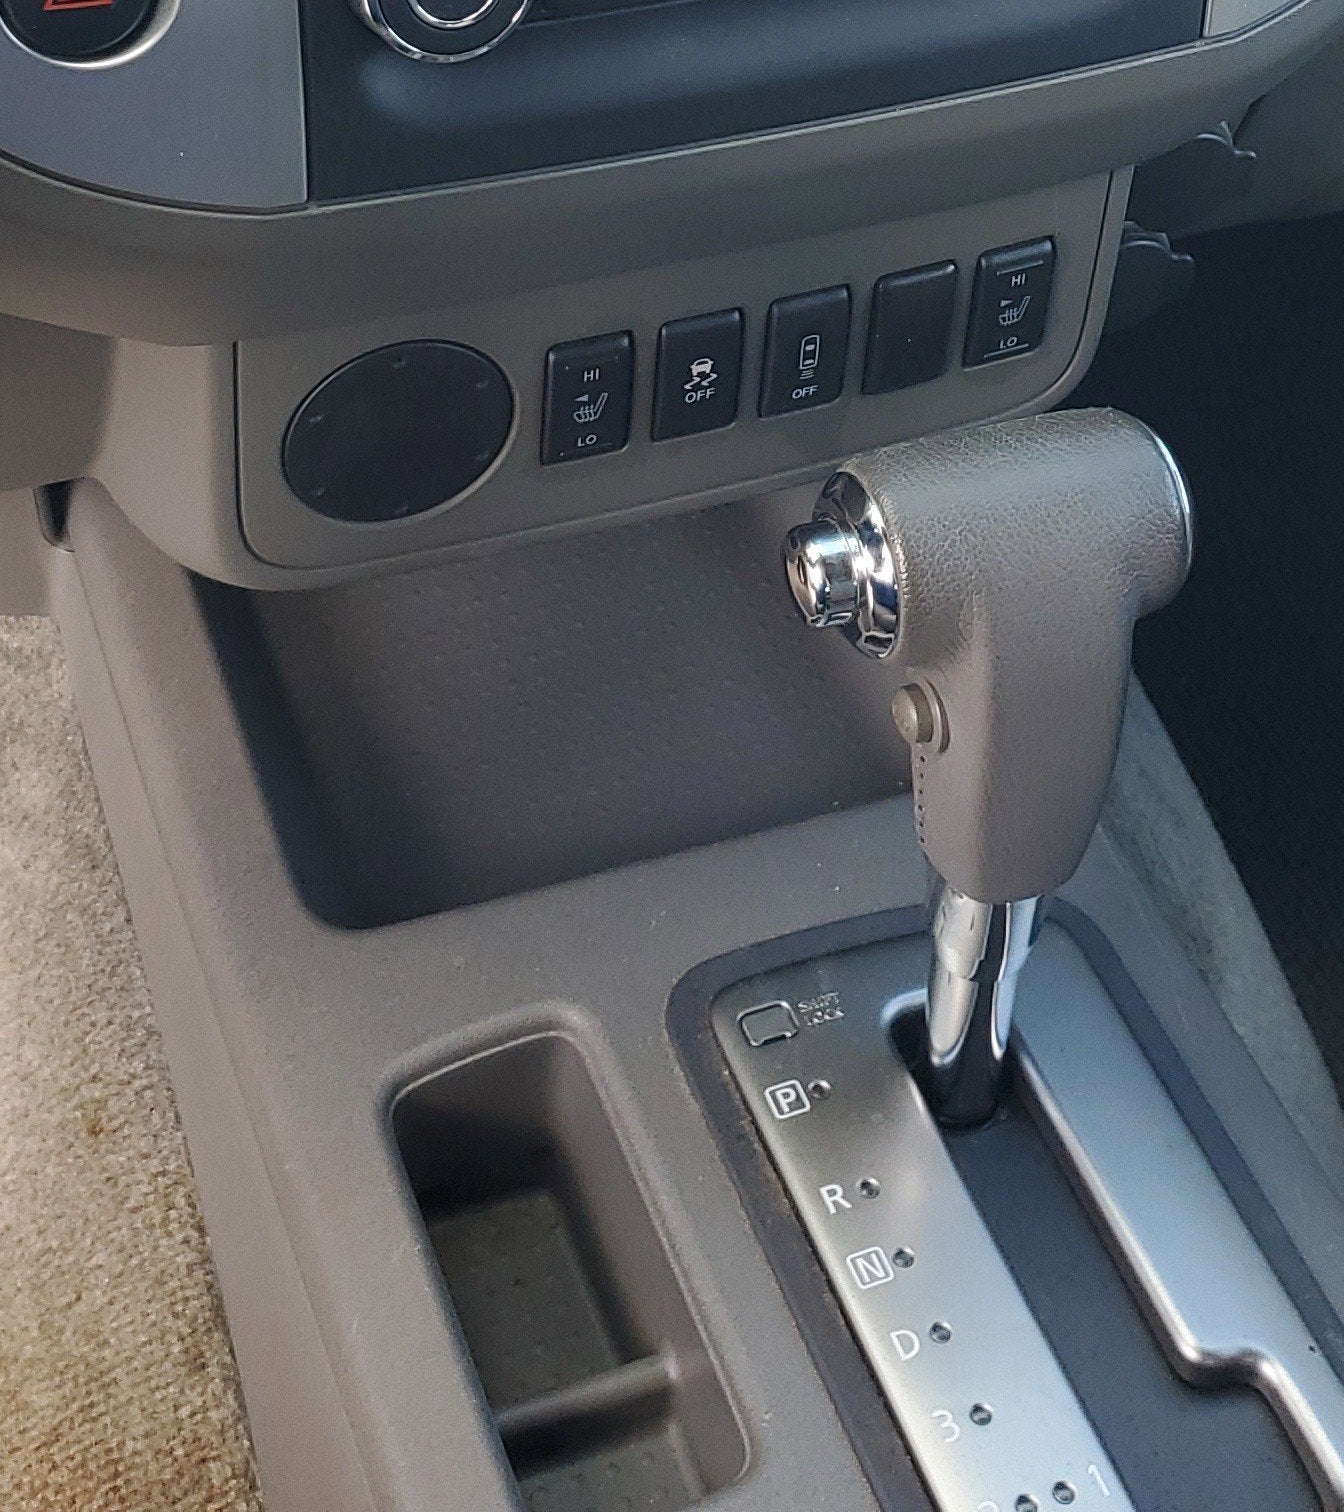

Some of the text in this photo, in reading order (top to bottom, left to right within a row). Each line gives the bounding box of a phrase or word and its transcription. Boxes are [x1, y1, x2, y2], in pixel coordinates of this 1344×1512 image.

[1011, 273, 1026, 286] HI
[583, 368, 599, 382] HI
[684, 388, 716, 404] OFF
[792, 385, 818, 399] OFF
[577, 434, 597, 447] LO
[775, 1088, 797, 1113] P
[819, 1184, 851, 1214] R
[857, 1254, 886, 1281] N
[890, 1330, 920, 1361] D
[931, 1410, 961, 1442] 3
[1088, 1464, 1110, 1497] 1
